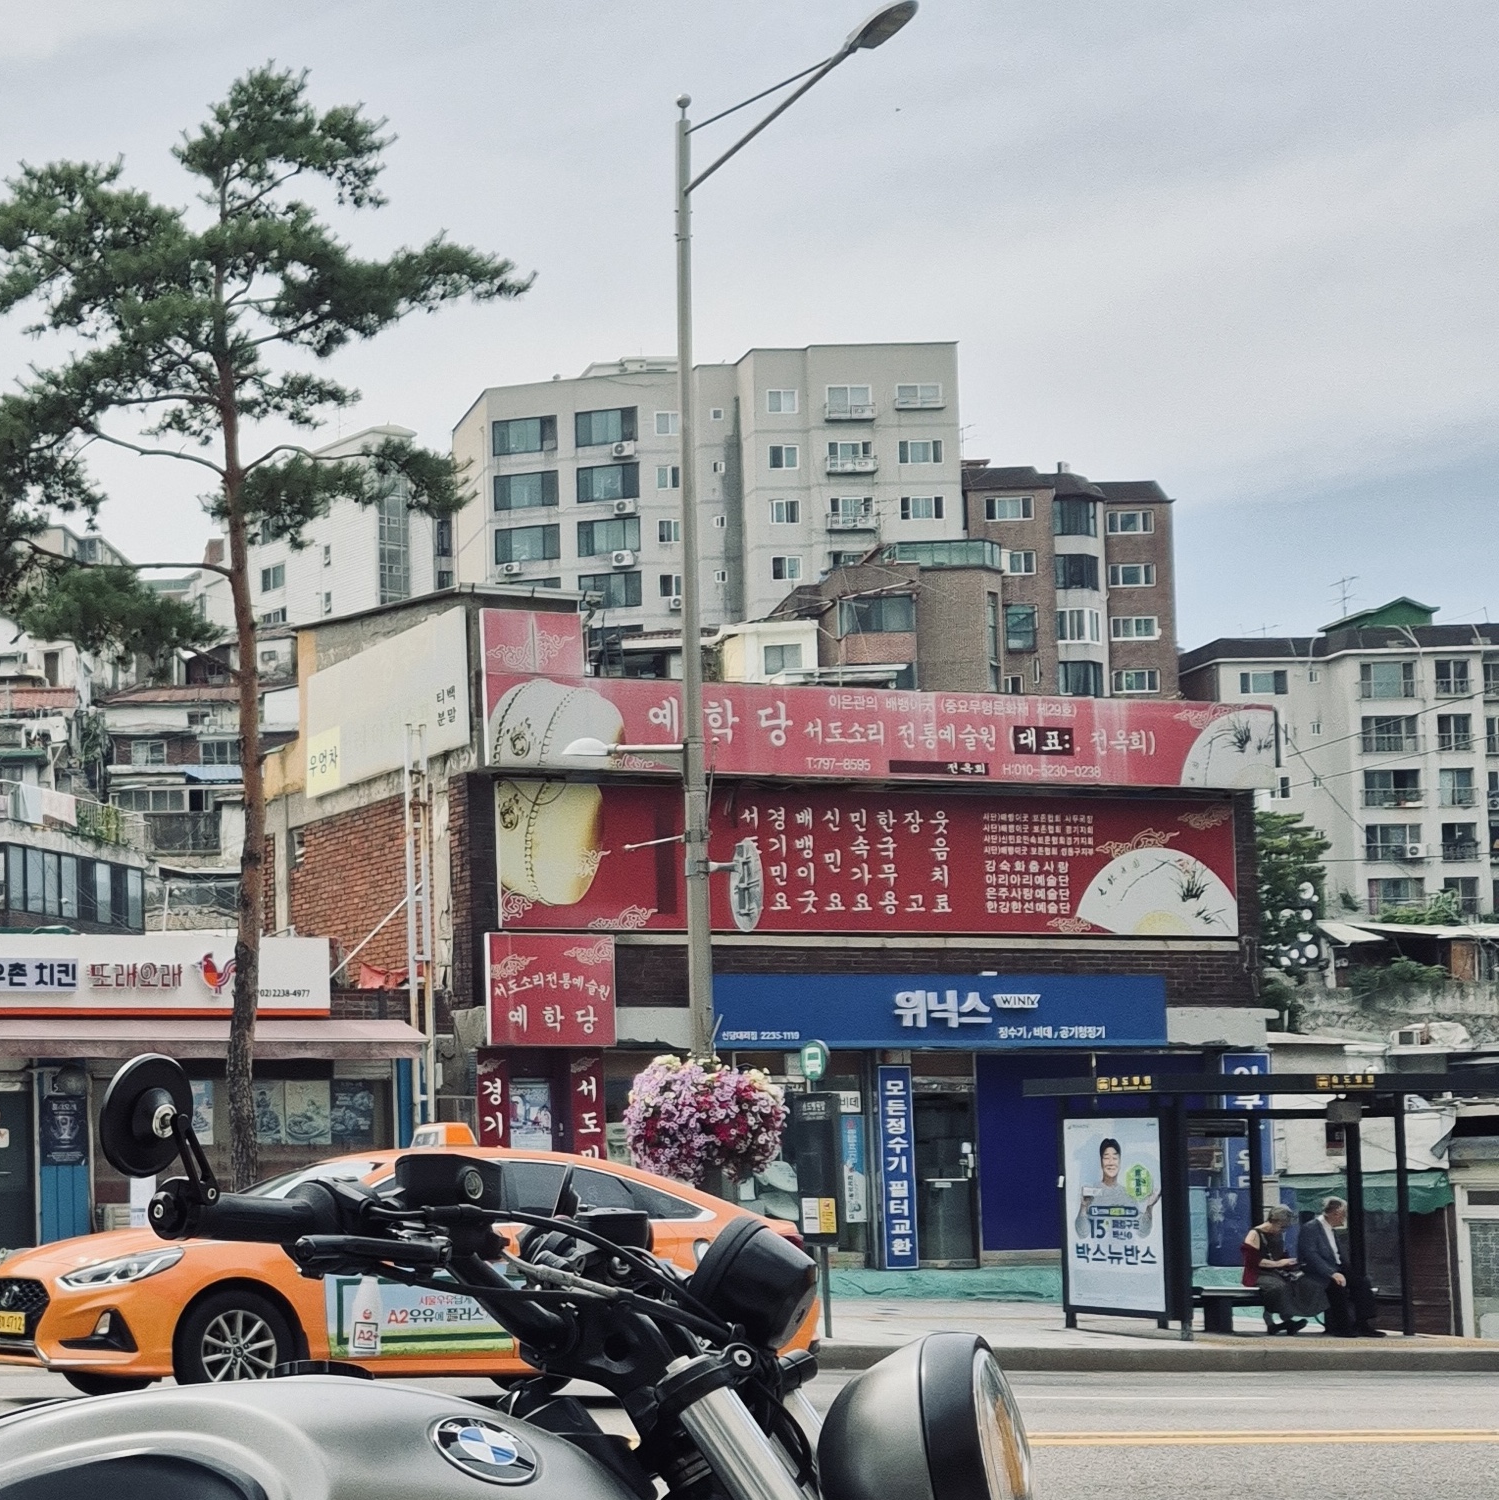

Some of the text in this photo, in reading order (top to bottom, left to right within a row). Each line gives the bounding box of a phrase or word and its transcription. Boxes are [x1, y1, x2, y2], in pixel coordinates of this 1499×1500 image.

[829, 694, 878, 712] 이은관의
[803, 718, 885, 747] 서도소리
[897, 721, 996, 751] 전통예술원
[309, 746, 339, 777] 우엉차
[806, 757, 871, 772] T:797-8595
[767, 806, 792, 911] 경기민요
[794, 806, 819, 915] 배뱅이굿
[821, 807, 846, 911] 신민요
[849, 807, 873, 911] 민속가요
[876, 808, 900, 915] 한국무용
[929, 810, 953, 914] 웃음치료
[35, 963, 77, 988] 치킨
[86, 962, 182, 988] 또래오래
[494, 971, 611, 1001] 서도소리전통예술원
[894, 990, 993, 1028] 위닉스
[482, 1077, 504, 1148] 경기
[884, 1080, 913, 1256] 모든정수기 필터교환
[1075, 1243, 1158, 1266] 박스뉴반스
